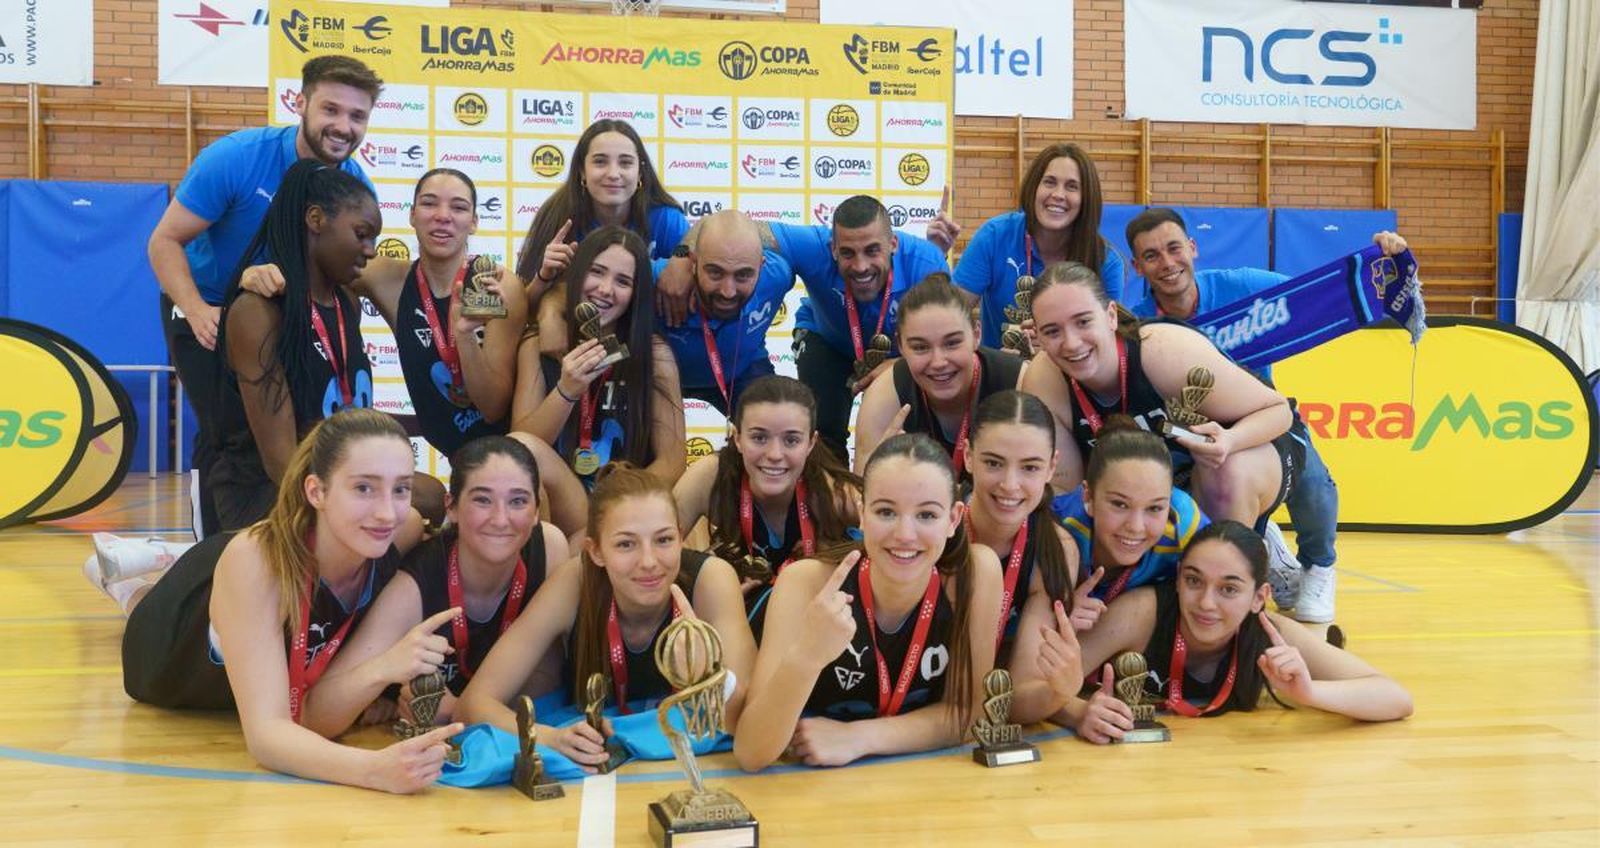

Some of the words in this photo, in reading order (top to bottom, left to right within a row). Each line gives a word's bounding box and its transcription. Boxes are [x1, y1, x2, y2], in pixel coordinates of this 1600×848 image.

[313, 17, 345, 31] FBM
[313, 41, 344, 50] MADRID
[421, 25, 497, 56] LIGA
[872, 40, 900, 54] FBM
[760, 46, 810, 65] COPA
[871, 63, 900, 71] MADRID
[893, 89, 917, 97] Madrid
[1202, 91, 1300, 108] CONSULTORÍA
[1304, 93, 1404, 111] TECNOLÓGICA
[522, 98, 564, 116] LIGA
[685, 107, 702, 116] FBM
[766, 110, 795, 120] COPA
[378, 146, 397, 155] FBM
[758, 157, 776, 166] FBM
[838, 159, 866, 169] COPA
[682, 201, 713, 217] IGA
[909, 208, 936, 218] COPA
[380, 345, 398, 354] FBM
[899, 643, 920, 693] BALONCESTO
